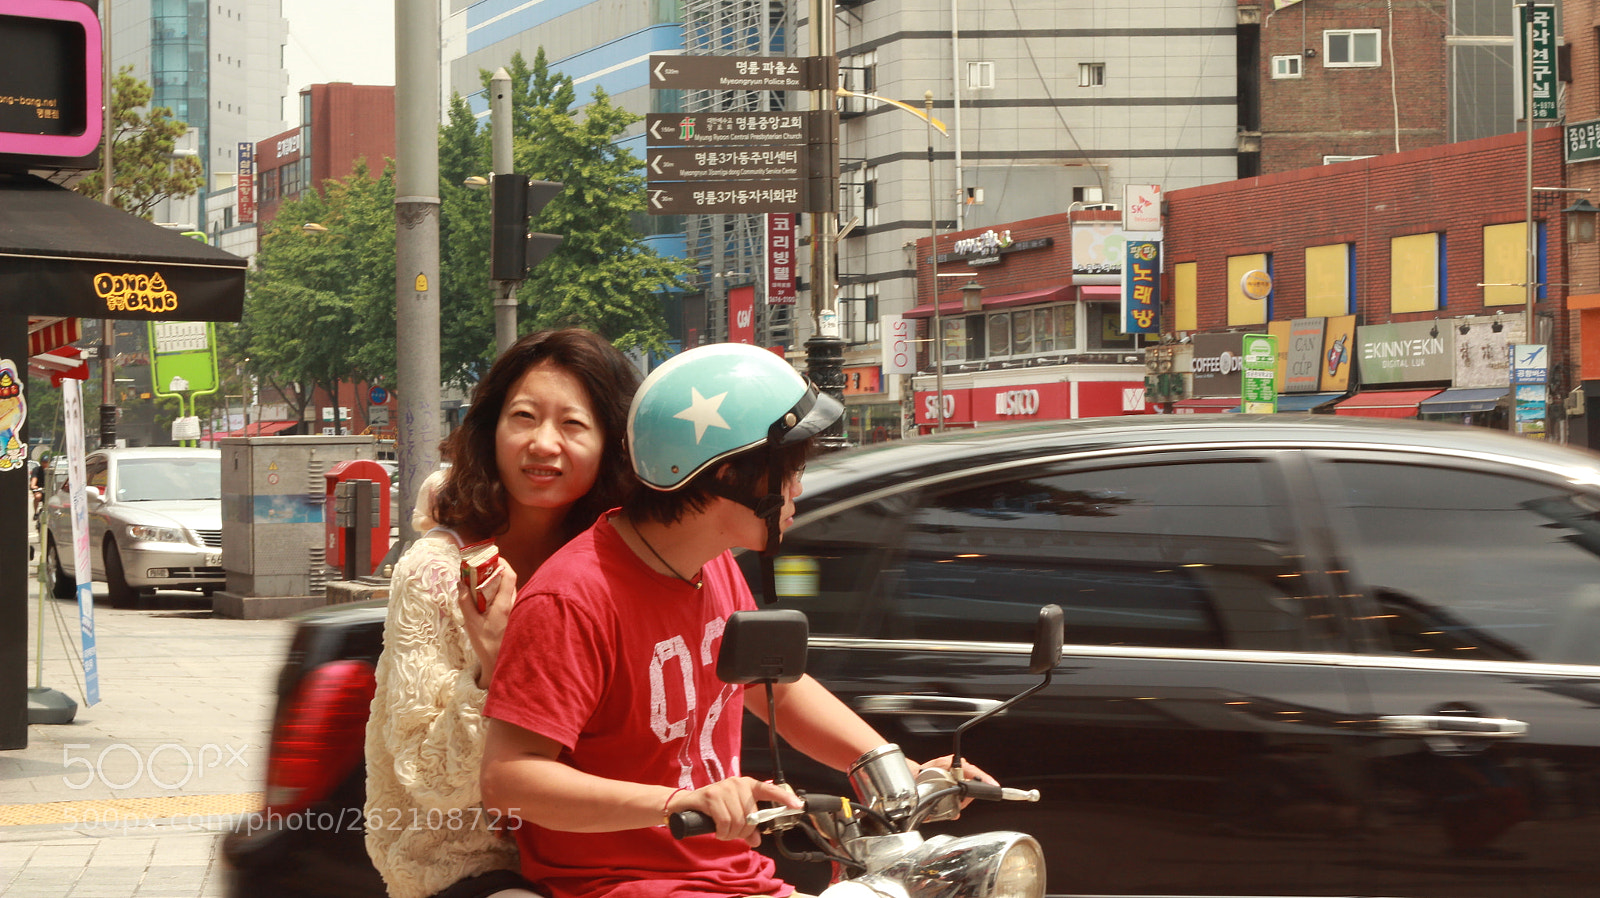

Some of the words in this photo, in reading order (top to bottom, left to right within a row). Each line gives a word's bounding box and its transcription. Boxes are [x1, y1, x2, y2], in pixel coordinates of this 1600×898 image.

[736, 61, 760, 75] 명륜
[762, 61, 800, 75] 파출소
[764, 77, 785, 85] Police
[735, 115, 802, 131] 명륜중앙교회
[750, 133, 782, 141] Presbyterian
[694, 150, 798, 166] 명륜3가동주민센터
[693, 189, 798, 206] 명륜3가동자치회관
[1131, 204, 1144, 214] SK
[773, 212, 790, 281] 코리빙텔
[124, 290, 178, 313] BANG
[1131, 263, 1156, 329] 노래방
[737, 304, 753, 329] CGV
[893, 321, 908, 368] STCO
[1295, 337, 1314, 352] CAN
[1192, 357, 1220, 373] COFFEE
[1292, 361, 1313, 376] CUP
